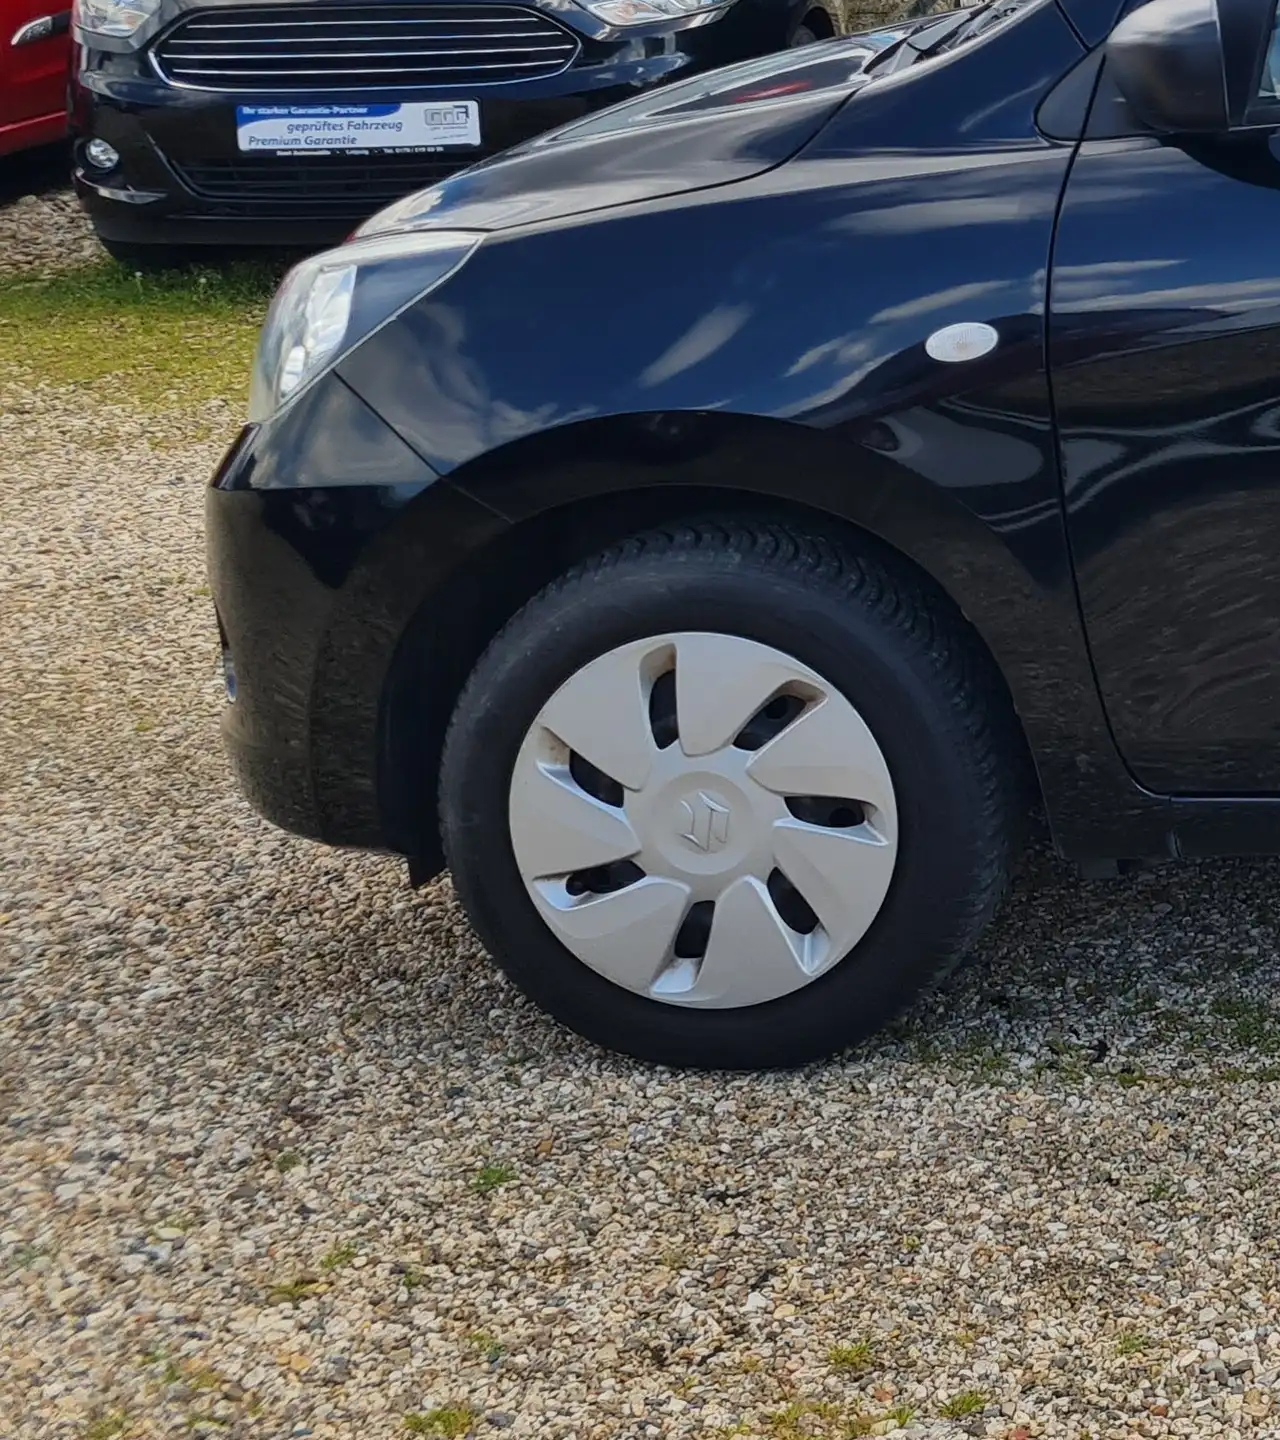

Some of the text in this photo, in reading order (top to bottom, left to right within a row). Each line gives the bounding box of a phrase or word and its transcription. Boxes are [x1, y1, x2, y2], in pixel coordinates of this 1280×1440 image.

[287, 120, 403, 134] geprüftes Fahrzeug
[248, 134, 357, 147] Premium Garantie
